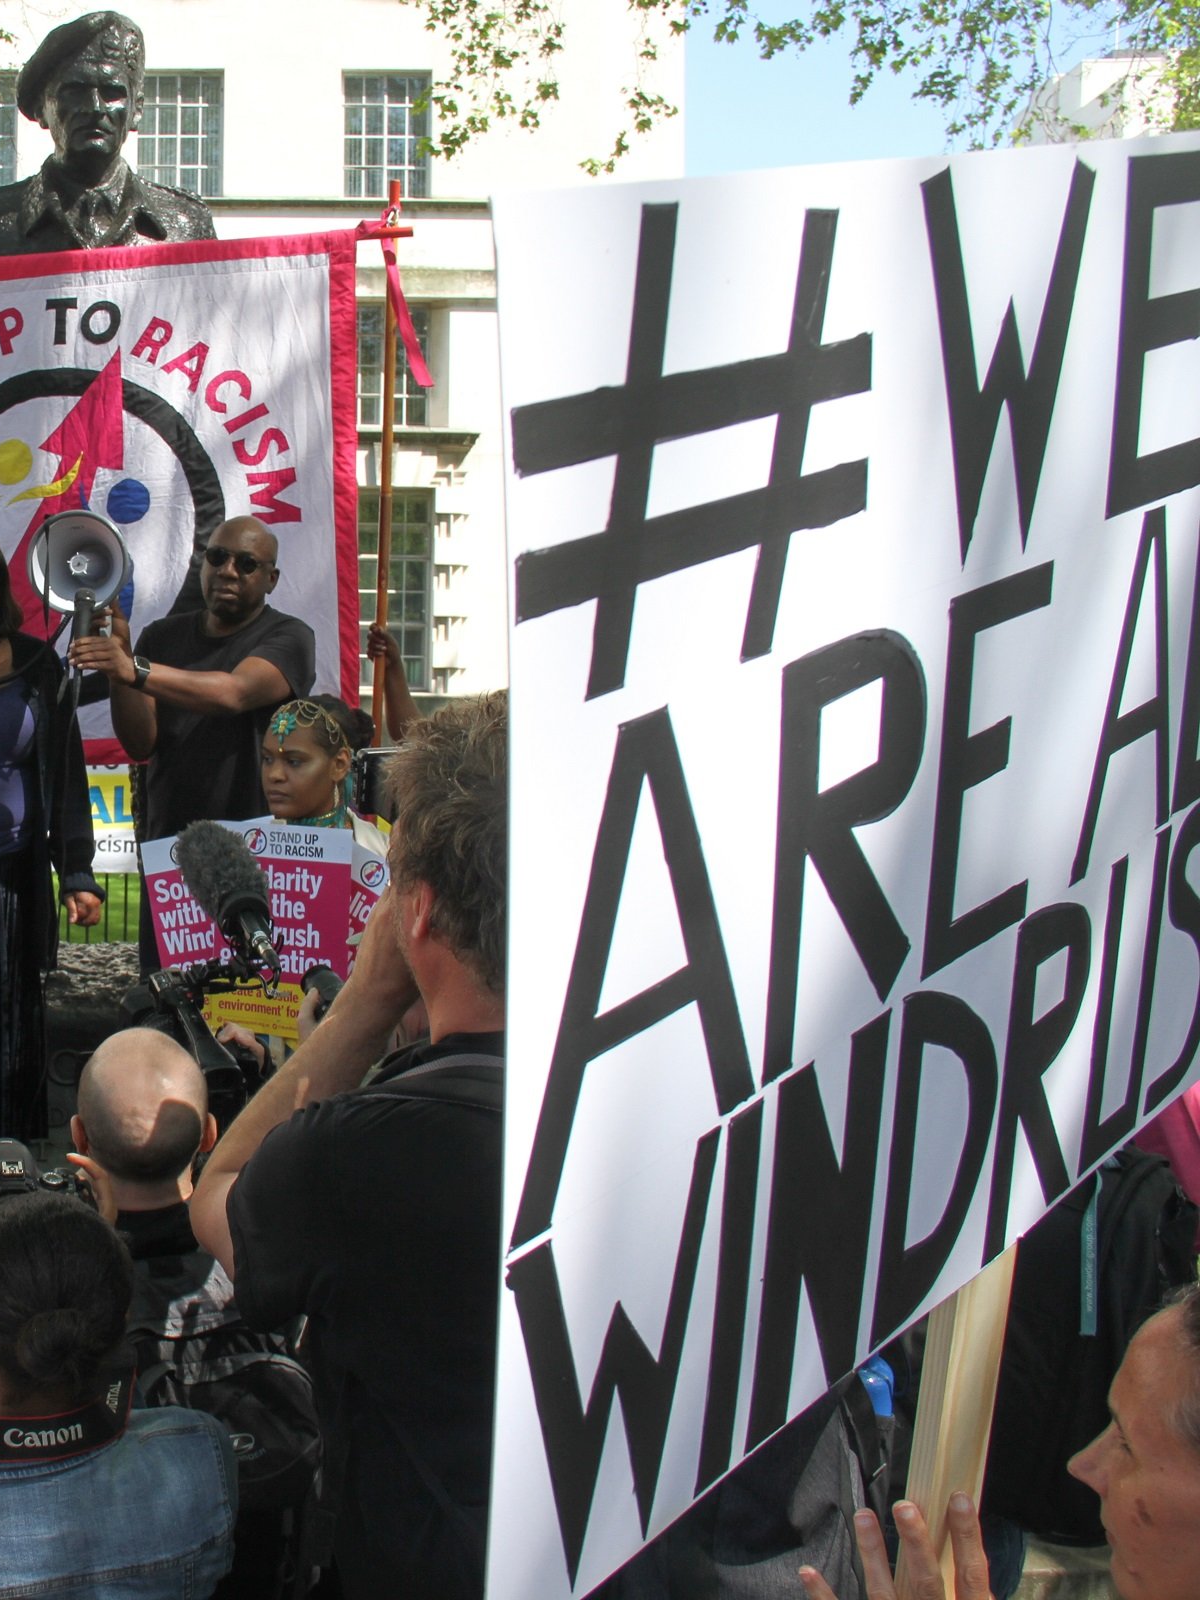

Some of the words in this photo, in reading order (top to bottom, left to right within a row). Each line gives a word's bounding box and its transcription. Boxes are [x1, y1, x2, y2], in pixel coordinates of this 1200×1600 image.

[46, 296, 122, 346] TO
[131, 316, 303, 525] RACISM
[269, 831, 302, 843] STAND
[304, 833, 319, 845] UP
[269, 843, 283, 855] TO
[284, 844, 324, 858] RACISM
[158, 900, 207, 929] with
[271, 893, 306, 920] the
[508, 560, 1054, 1258] ARE
[504, 800, 1200, 1595] WINDRUS
[3, 1423, 83, 1449] Canon
